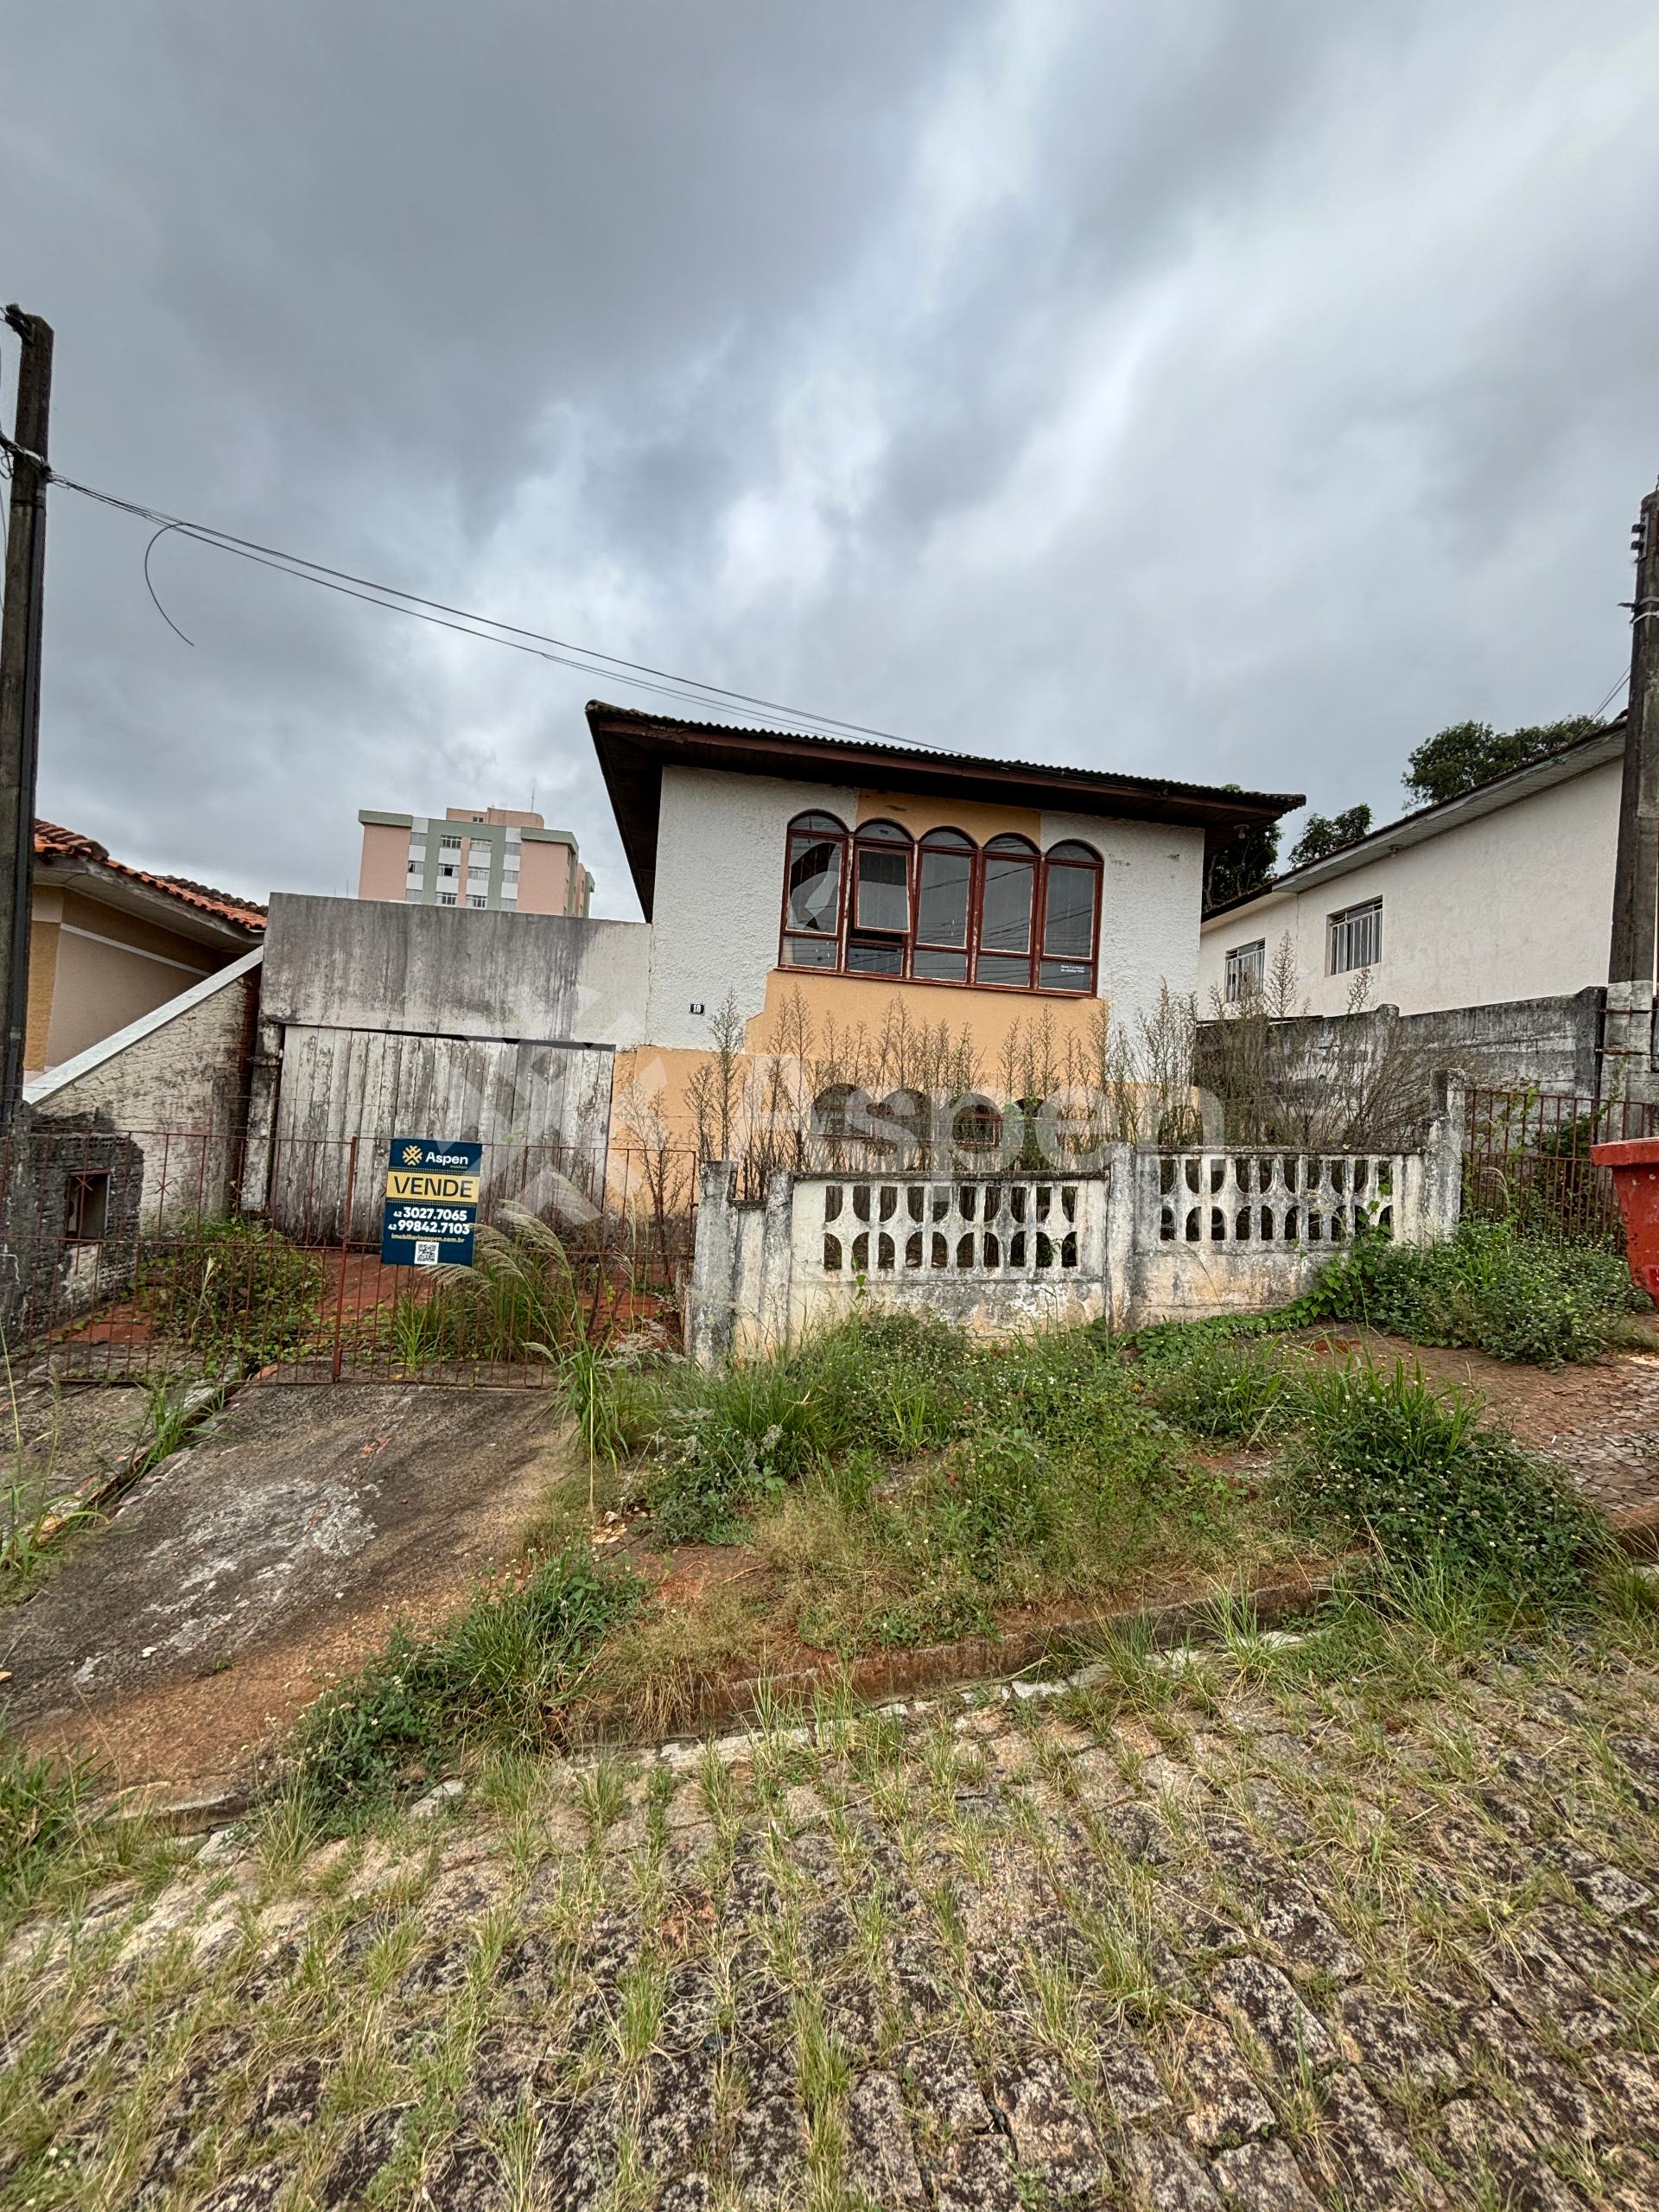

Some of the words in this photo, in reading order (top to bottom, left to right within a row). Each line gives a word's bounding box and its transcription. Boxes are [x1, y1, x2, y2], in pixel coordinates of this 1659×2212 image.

[424, 1151, 468, 1166] Aspen
[394, 1176, 474, 1198] VENDE
[403, 1206, 467, 1221] 3027.7065
[397, 1219, 470, 1235] 99842.7103
